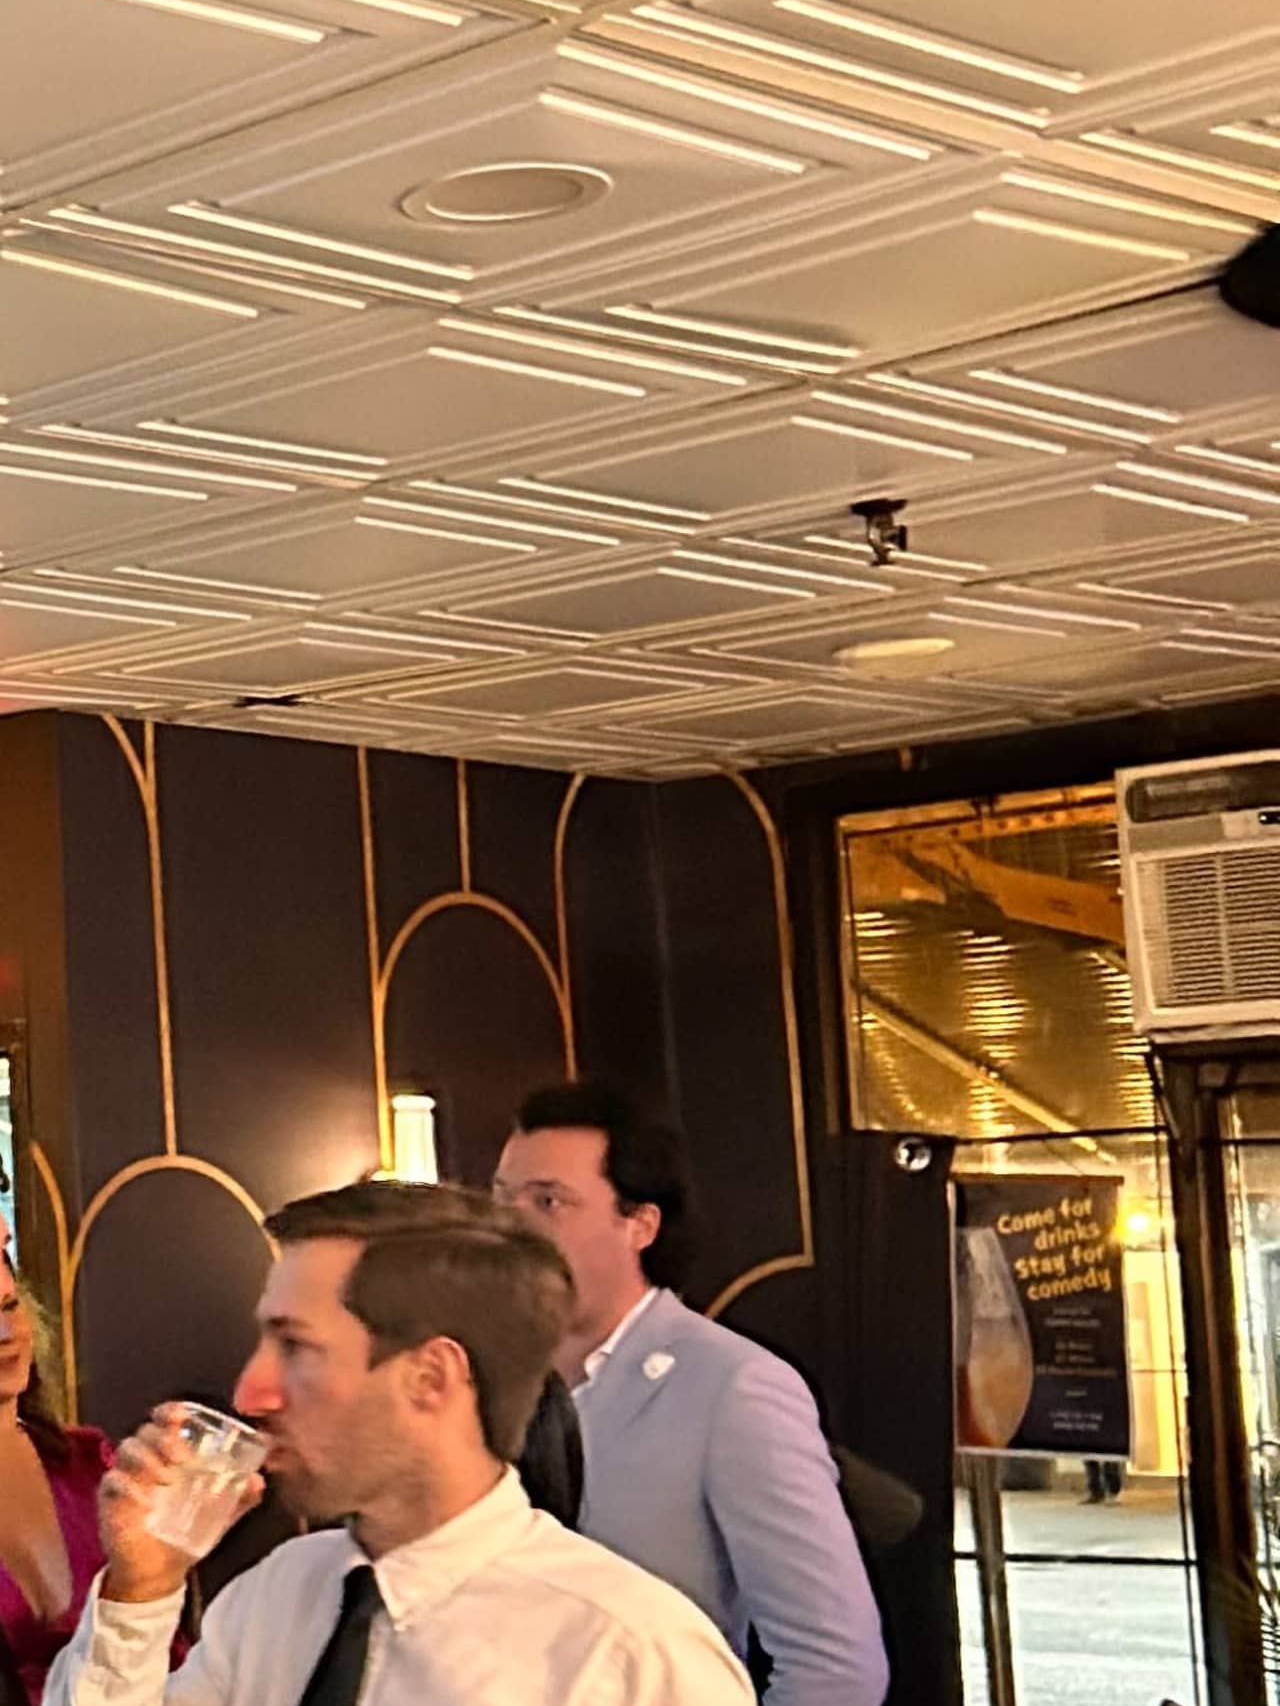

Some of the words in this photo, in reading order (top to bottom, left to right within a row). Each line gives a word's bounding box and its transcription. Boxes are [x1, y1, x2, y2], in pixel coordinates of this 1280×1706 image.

[997, 1207, 1056, 1235] Come
[1059, 1197, 1093, 1219] for
[1034, 1220, 1101, 1251] drinks
[1071, 1244, 1105, 1267] for
[1026, 1267, 1112, 1301] comedy
